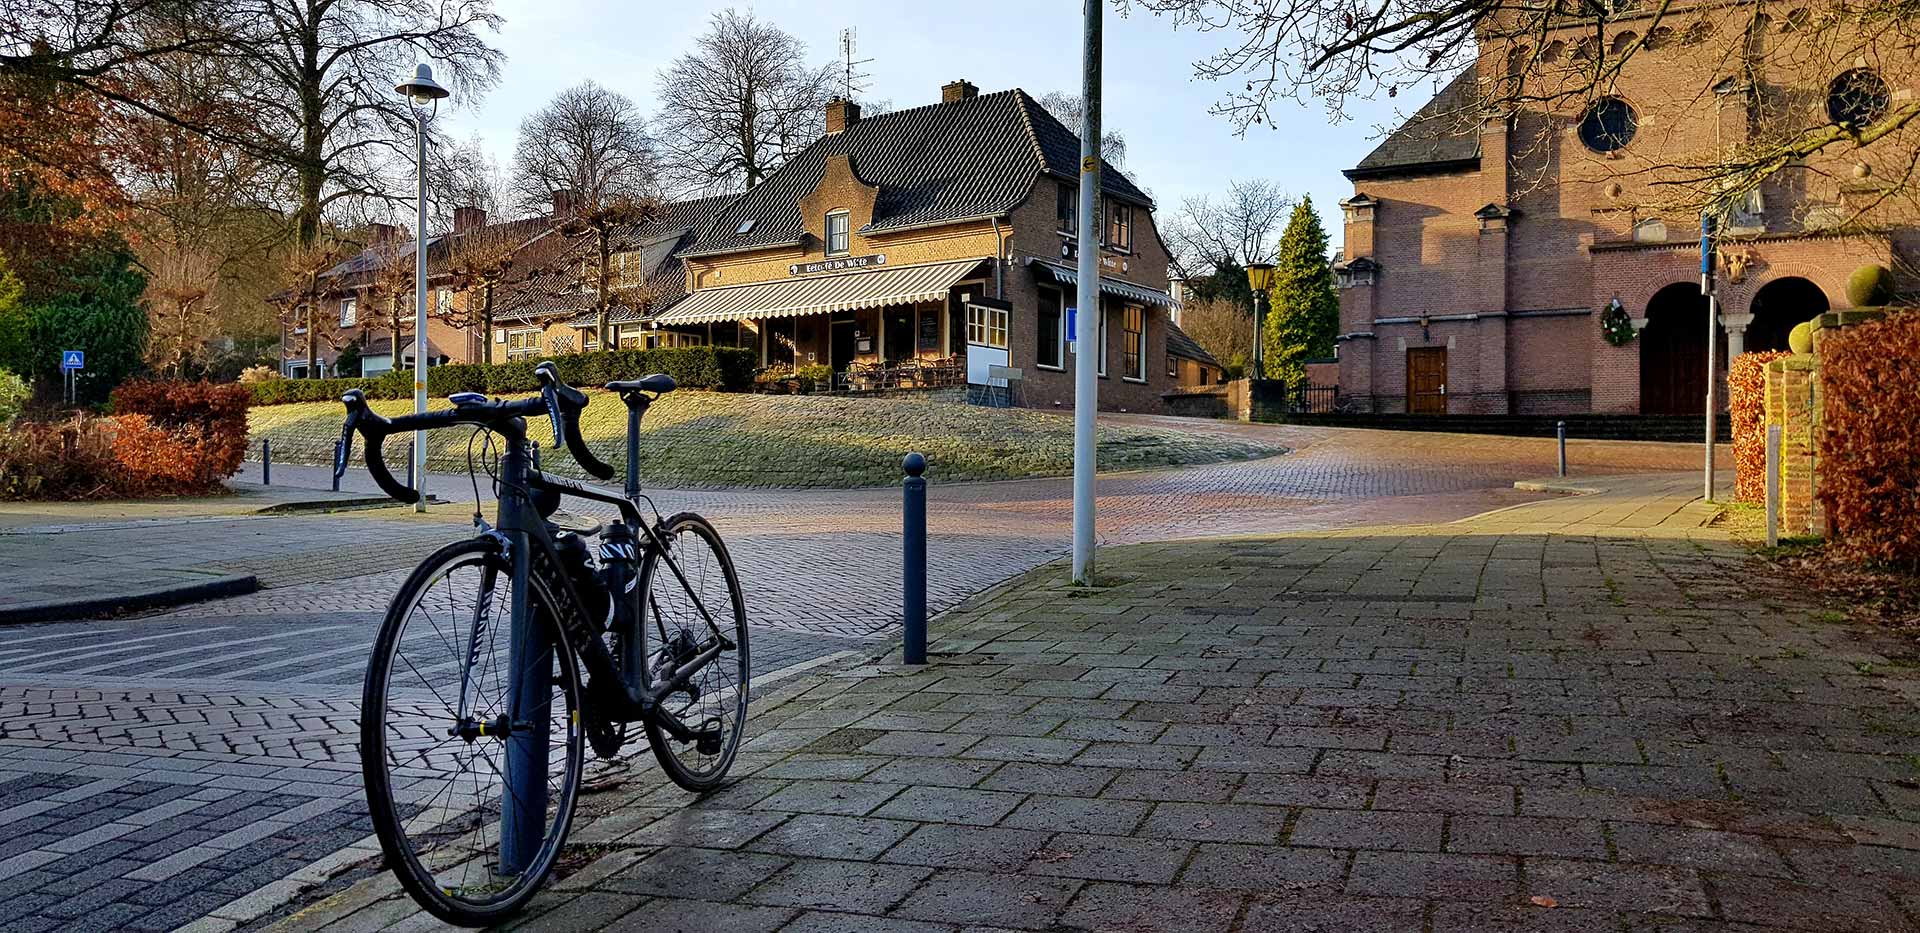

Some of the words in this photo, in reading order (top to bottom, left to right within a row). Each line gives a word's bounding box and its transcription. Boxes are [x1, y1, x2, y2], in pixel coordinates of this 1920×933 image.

[806, 262, 833, 272] Eetcafé
[834, 261, 845, 269] De
[846, 258, 868, 267] Witte
